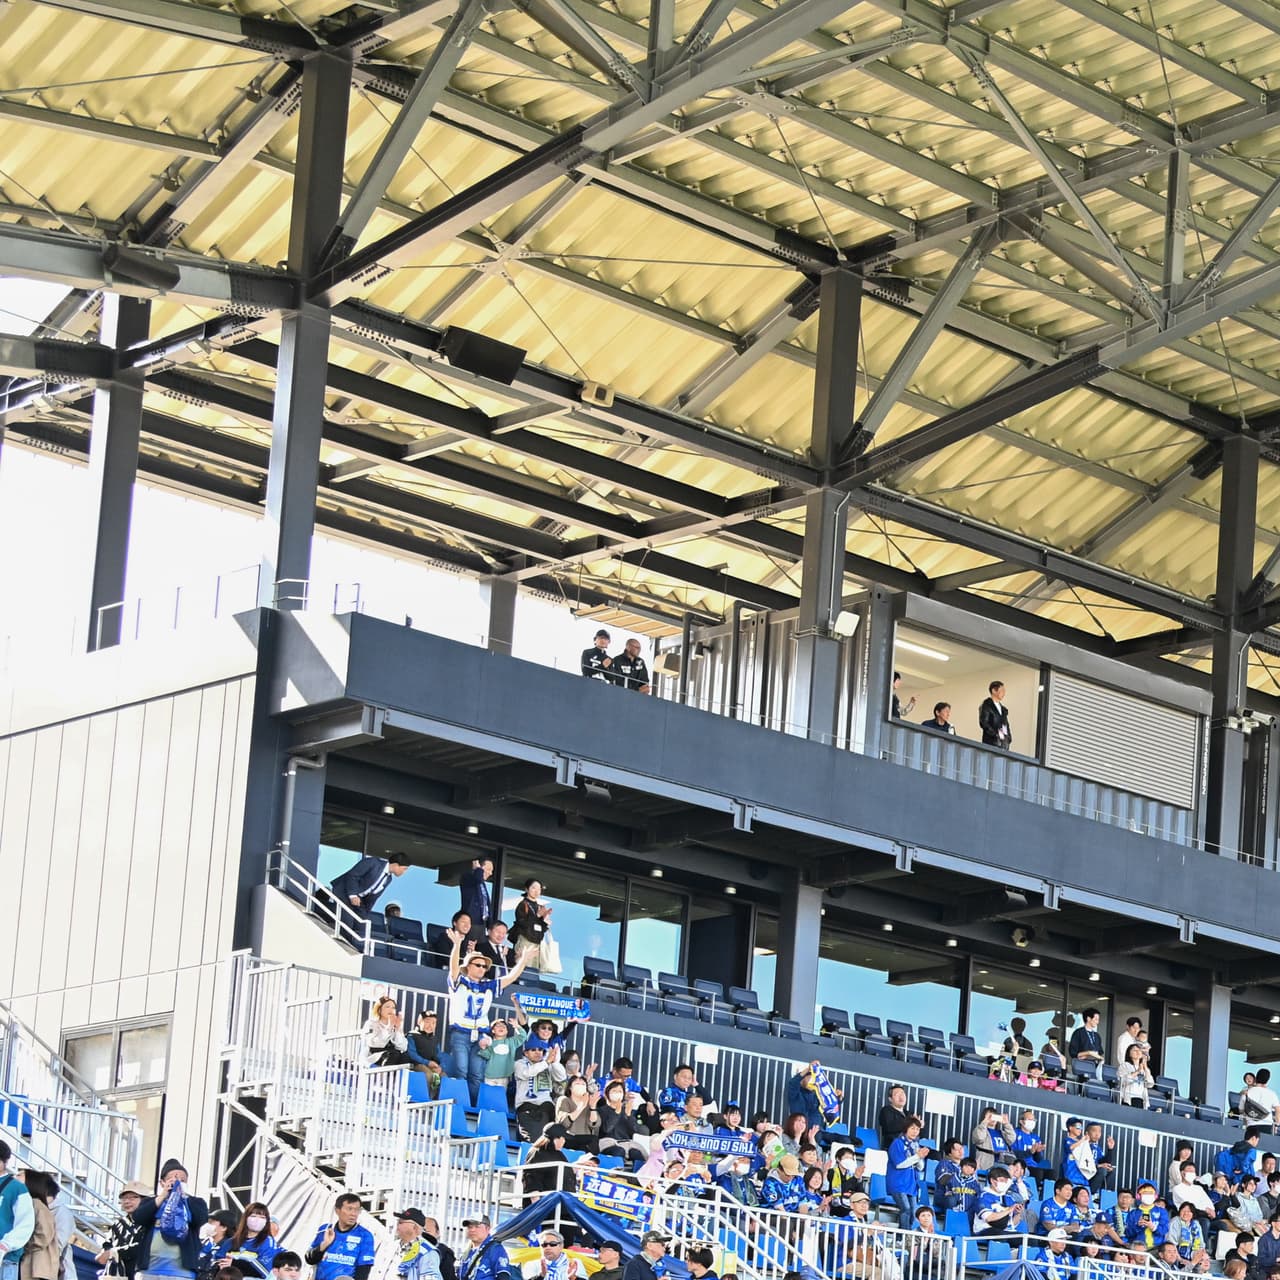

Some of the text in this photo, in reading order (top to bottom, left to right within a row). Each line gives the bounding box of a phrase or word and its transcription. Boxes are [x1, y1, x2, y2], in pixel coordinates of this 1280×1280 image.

[519, 995, 547, 1007] WESLEY
[700, 1137, 719, 1151] OUR
[720, 1140, 731, 1151] IS
[731, 1142, 754, 1155] THIS
